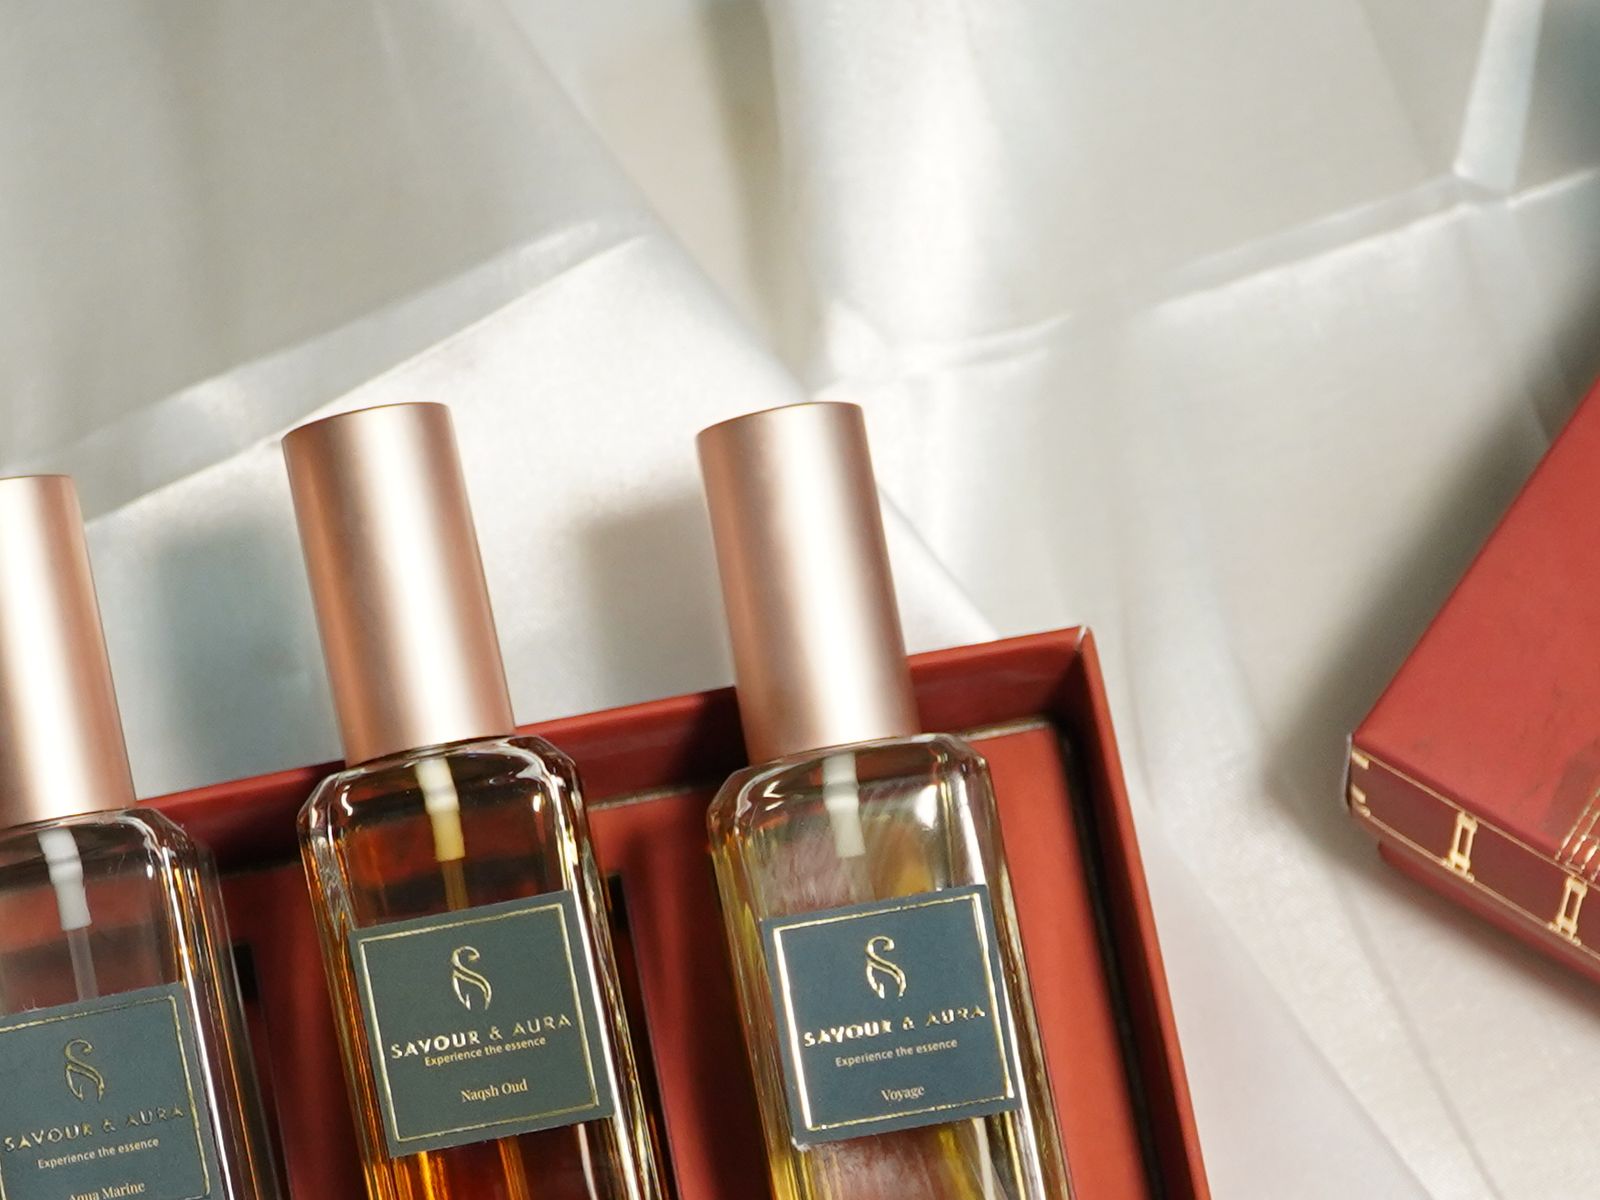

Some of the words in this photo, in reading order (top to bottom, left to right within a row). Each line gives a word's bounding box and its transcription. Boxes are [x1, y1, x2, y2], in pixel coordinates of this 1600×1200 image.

[902, 1017, 915, 1030] &
[925, 1005, 986, 1026] AURA
[391, 1029, 481, 1059] SAVOUR
[489, 1026, 503, 1040] &
[512, 1014, 572, 1036] AURA
[424, 1047, 482, 1067] Experience
[484, 1043, 503, 1057] the
[504, 1036, 546, 1052] essence
[835, 1049, 894, 1068] Experience
[895, 1045, 914, 1058] the
[916, 1039, 958, 1054] essence
[461, 1083, 499, 1103] Naqsh
[502, 1078, 529, 1095] Oud
[881, 1085, 925, 1102] Voyage
[4, 1124, 93, 1152] SAVOUR
[103, 1119, 116, 1132] &
[125, 1104, 185, 1128] AURA
[37, 1151, 95, 1170] Experience
[97, 1143, 116, 1158] the
[117, 1137, 160, 1154] essence
[103, 1181, 145, 1200] Marine
